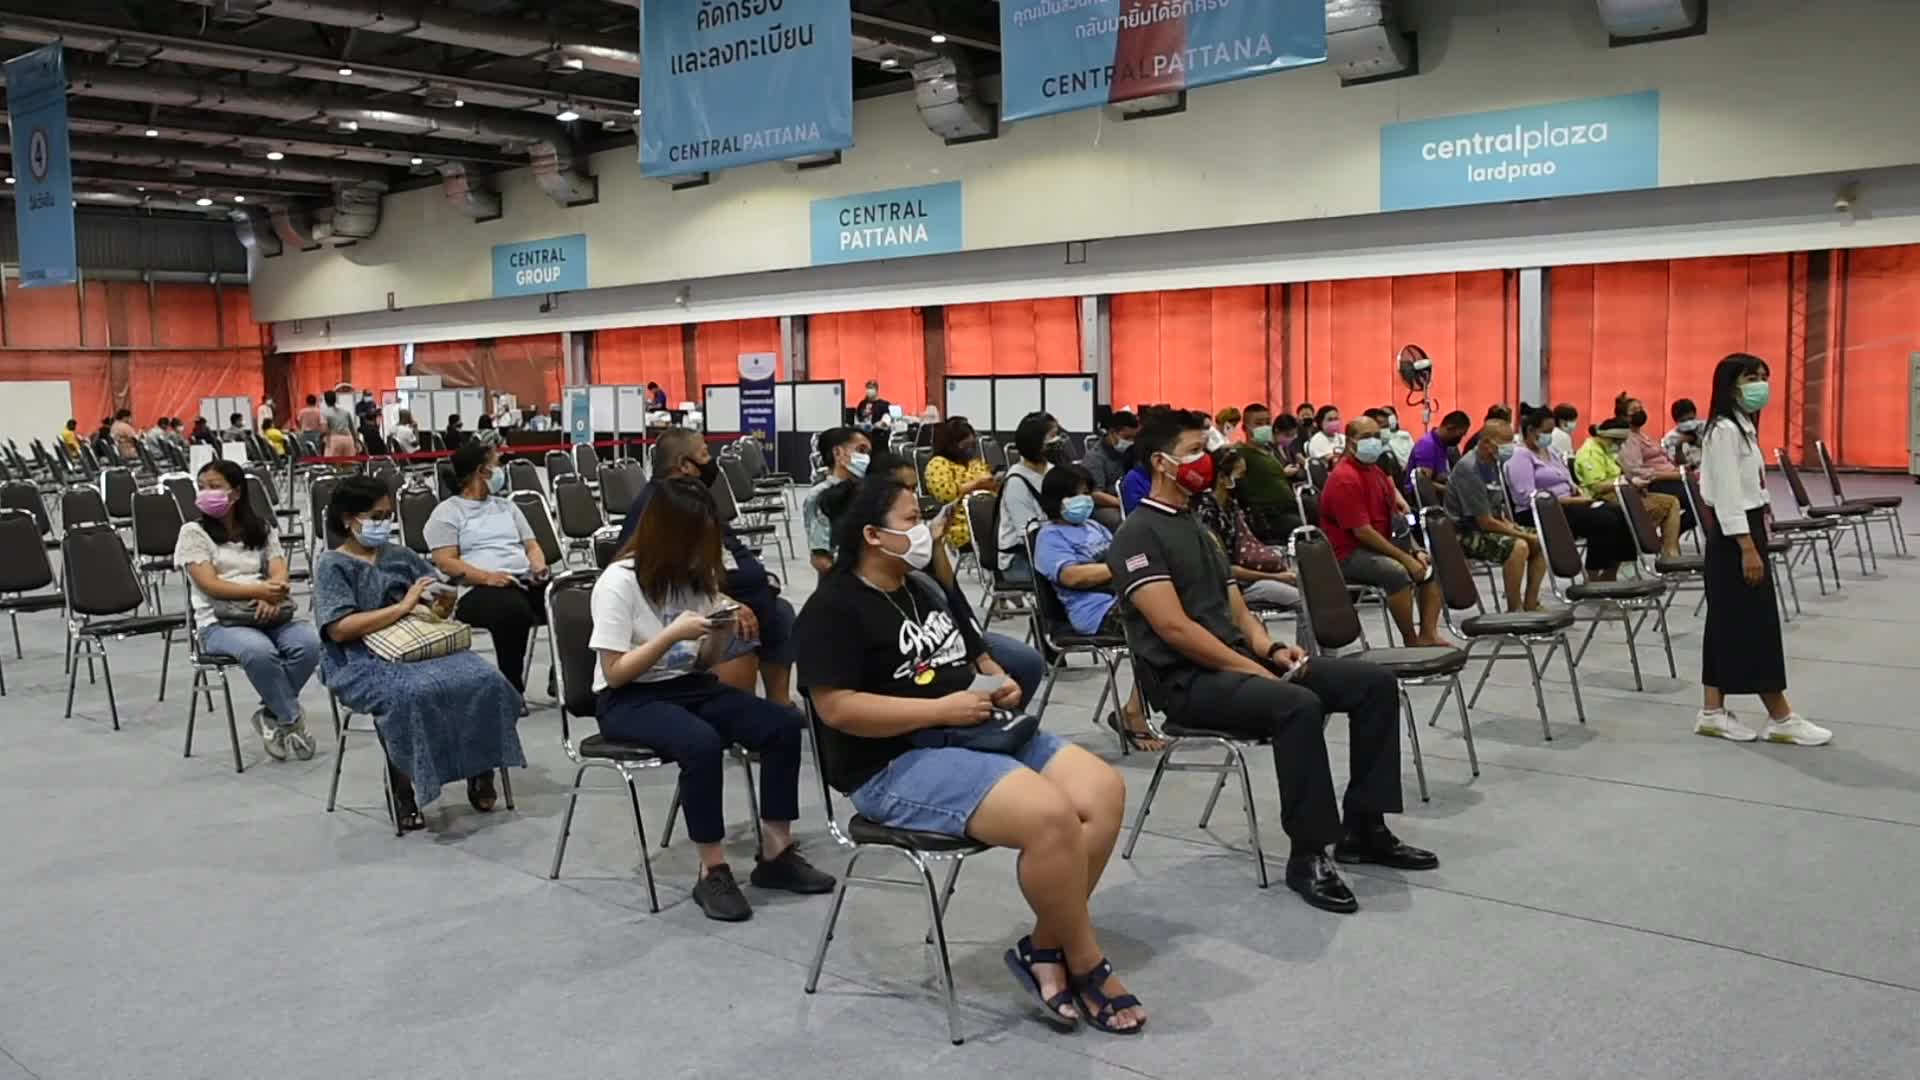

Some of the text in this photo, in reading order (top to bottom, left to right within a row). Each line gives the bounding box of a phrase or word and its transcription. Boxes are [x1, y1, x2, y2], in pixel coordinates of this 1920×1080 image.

[671, 23, 814, 75] และลงทะเบียน
[1422, 121, 1608, 160] centralplaza
[1467, 161, 1556, 183] lardprao
[838, 200, 928, 226] CENTRAL
[840, 223, 928, 251] PATTANA
[510, 248, 566, 267] CENTRAL
[516, 266, 561, 286] GROUP
